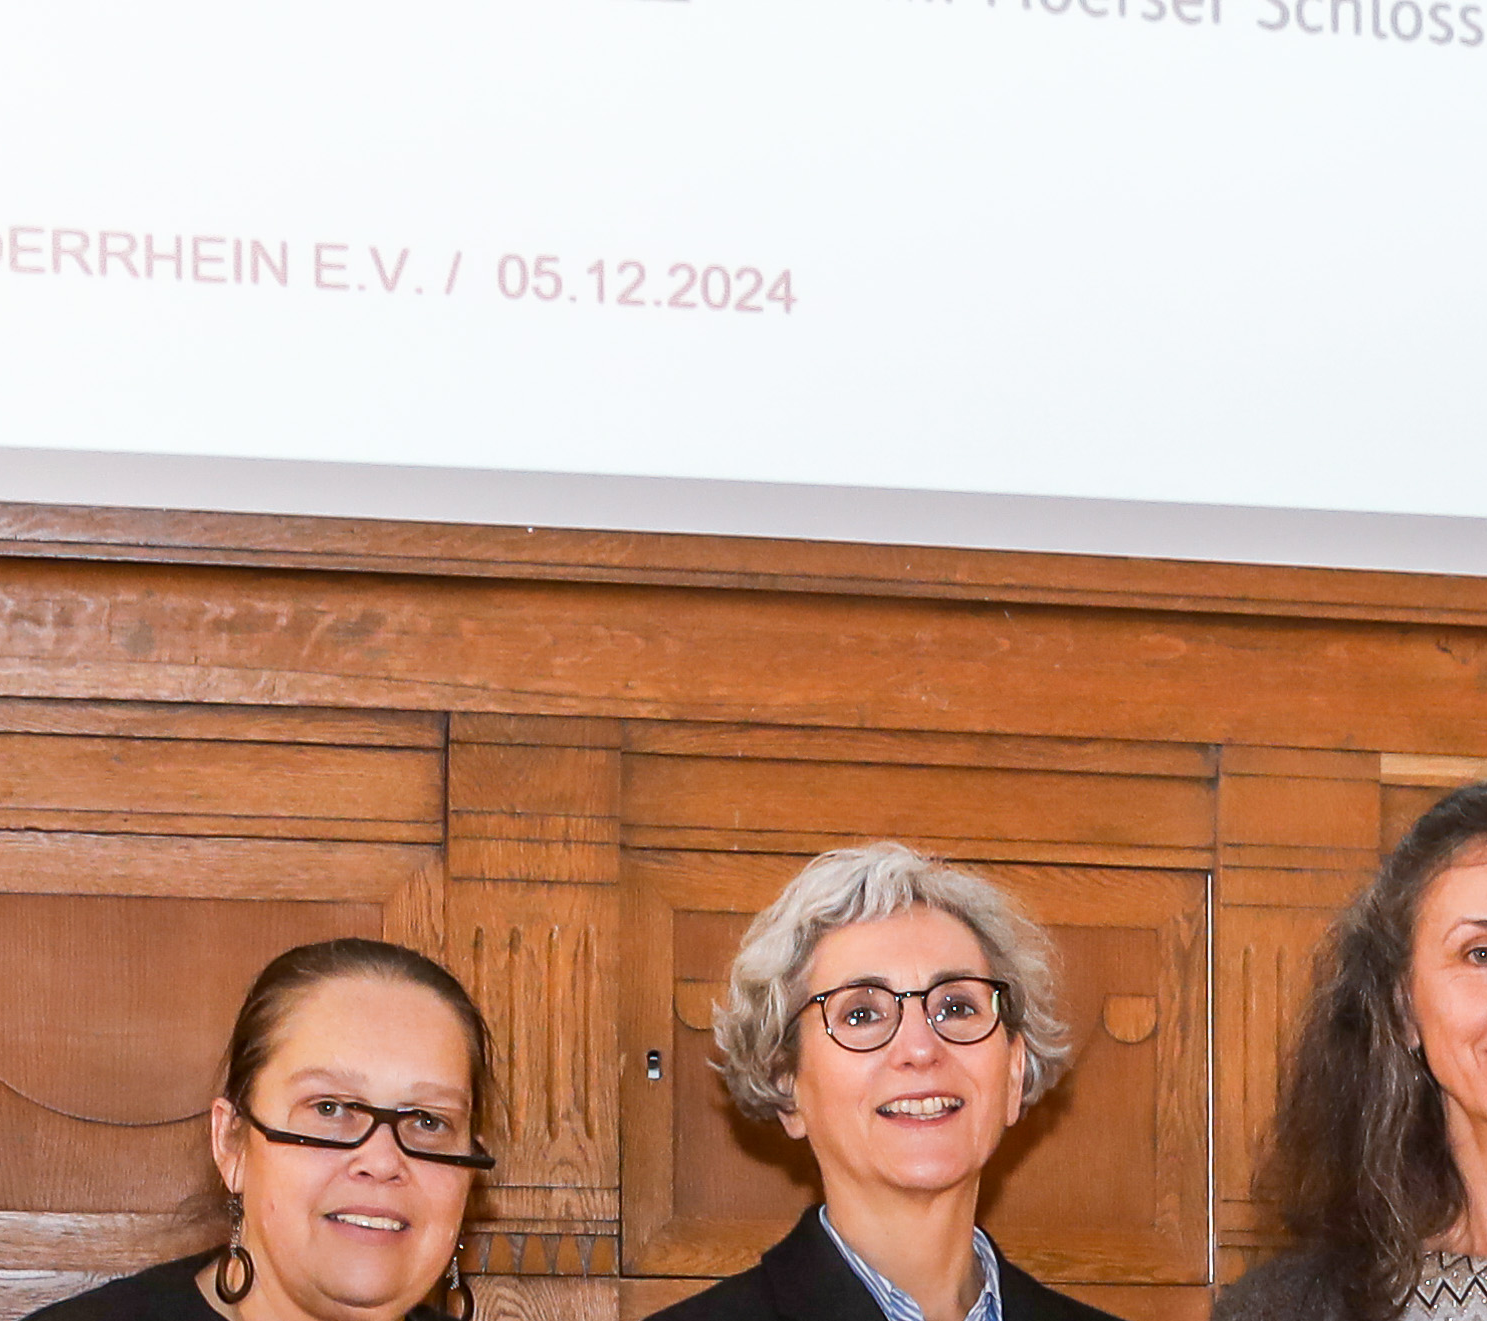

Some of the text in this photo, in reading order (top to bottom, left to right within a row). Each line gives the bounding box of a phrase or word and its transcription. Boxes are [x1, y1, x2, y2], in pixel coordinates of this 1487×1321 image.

[1257, 0, 1485, 48] Schloss
[313, 241, 425, 295] E.V.
[496, 253, 798, 315] 05.12.2024
